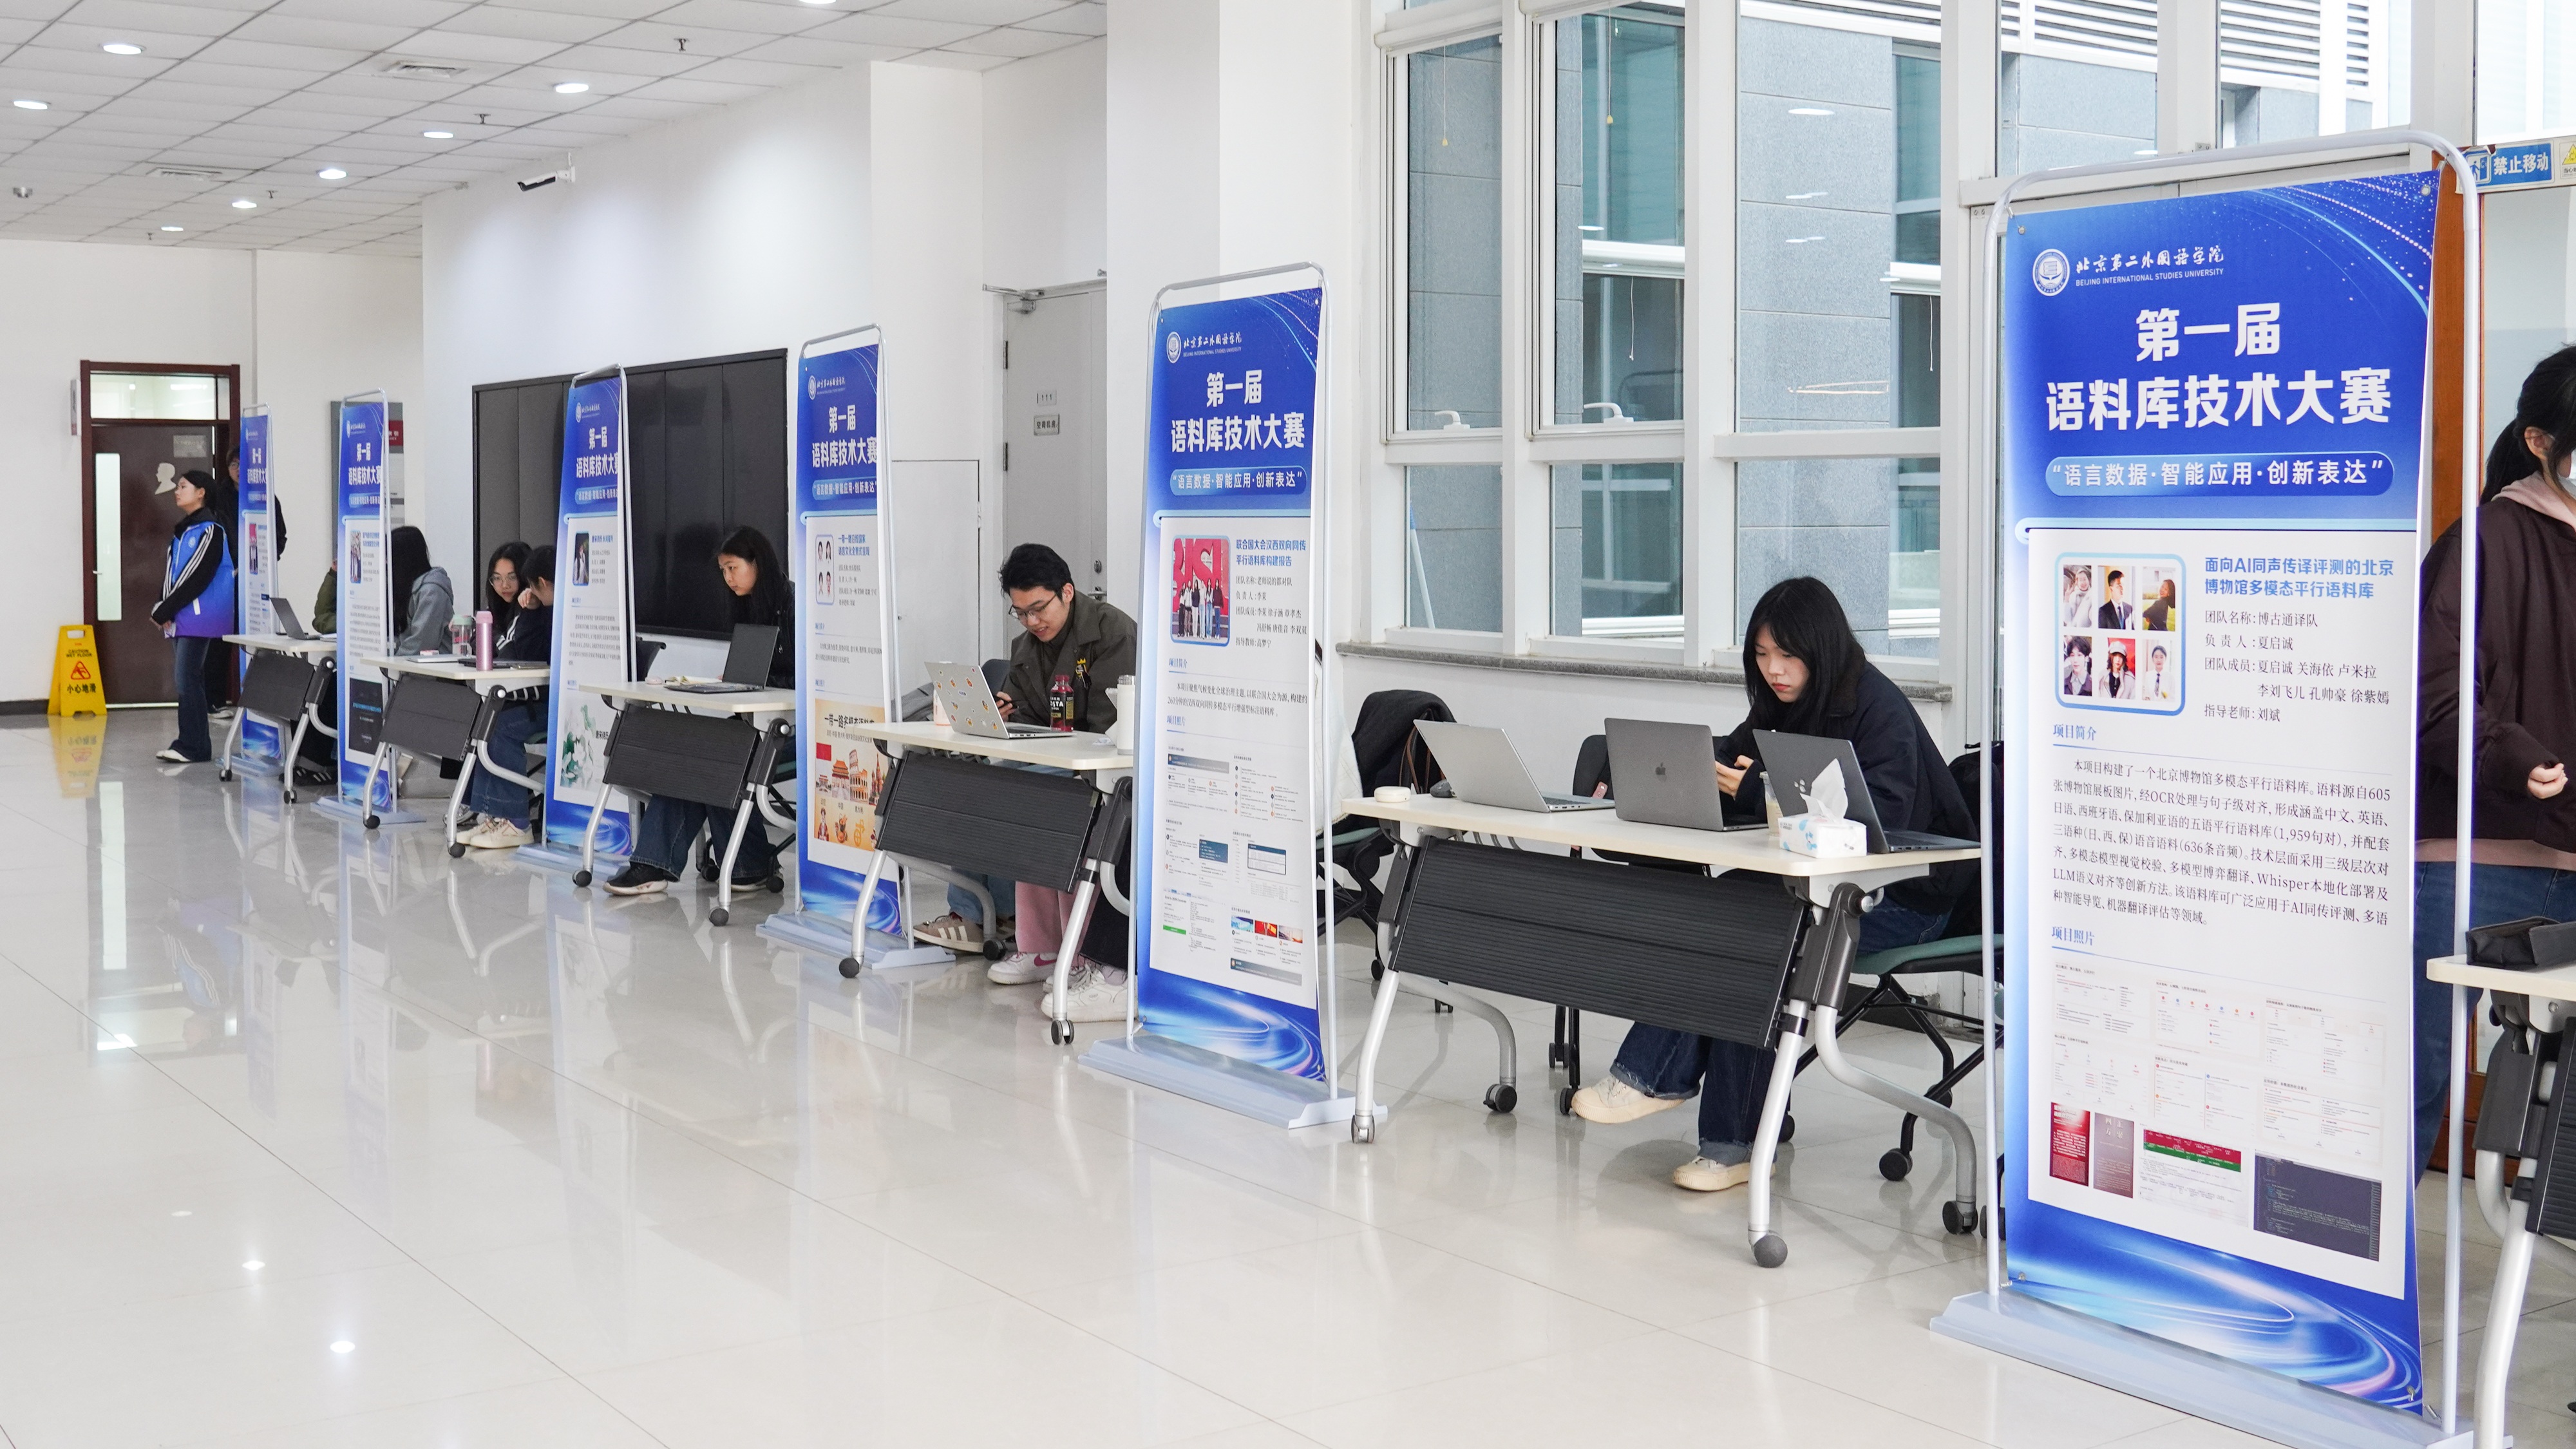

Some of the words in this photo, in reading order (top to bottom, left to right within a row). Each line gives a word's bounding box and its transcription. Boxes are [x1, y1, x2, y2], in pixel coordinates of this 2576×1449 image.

[2494, 152, 2548, 175] 禁止移动
[2076, 278, 2101, 287] BEIJING
[2103, 274, 2154, 285] INTERNATIONAL
[2155, 272, 2183, 281] STUDIES
[2184, 268, 2224, 278] UNIVERSITY
[2136, 303, 2281, 361] 第一届
[1206, 369, 1262, 407] 第一届
[2046, 367, 2391, 431] 语料库技术大赛
[829, 404, 856, 433] 第一届
[589, 426, 607, 450] 第一届
[1171, 412, 1305, 453] 语料库技术大赛
[812, 437, 877, 468] 语料库技术大赛
[1236, 539, 1306, 551] 联合国大会汉西双向同传
[1236, 554, 1292, 567] 平行语料库构建报告
[2205, 557, 2394, 576] 面向AI同声传译评测的北京
[2205, 578, 2374, 599] 博物馆多模态平行语料库
[2297, 661, 2334, 677] 关海依
[2338, 663, 2377, 679] 卢米拉
[67, 683, 97, 694] 小心地滑
[2257, 684, 2305, 699] 李刘飞儿
[2309, 687, 2347, 702] 孔帅豪
[2053, 724, 2097, 741] 项目简介
[2052, 926, 2095, 945] 项目照片
